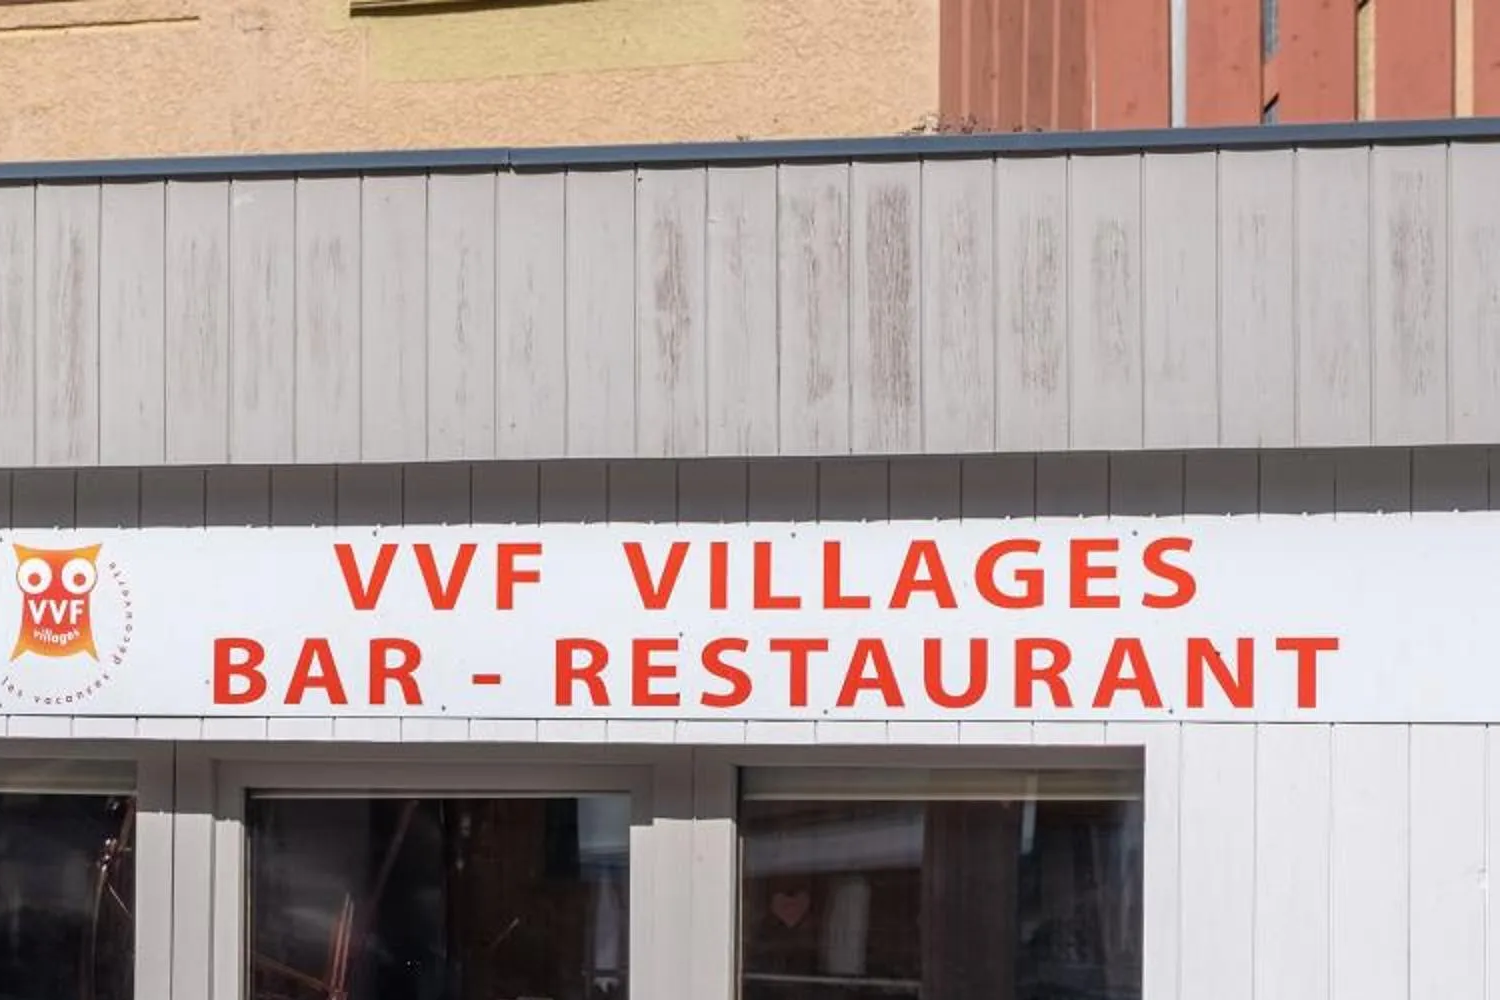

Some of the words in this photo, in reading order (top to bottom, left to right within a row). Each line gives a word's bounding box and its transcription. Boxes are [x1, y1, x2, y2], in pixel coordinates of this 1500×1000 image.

[334, 542, 542, 610] VVF
[623, 536, 1197, 610] VILLAGES
[27, 599, 84, 625] VVF
[33, 625, 80, 645] villages
[212, 637, 421, 706] BAR
[554, 636, 1340, 709] RESTAURANT
